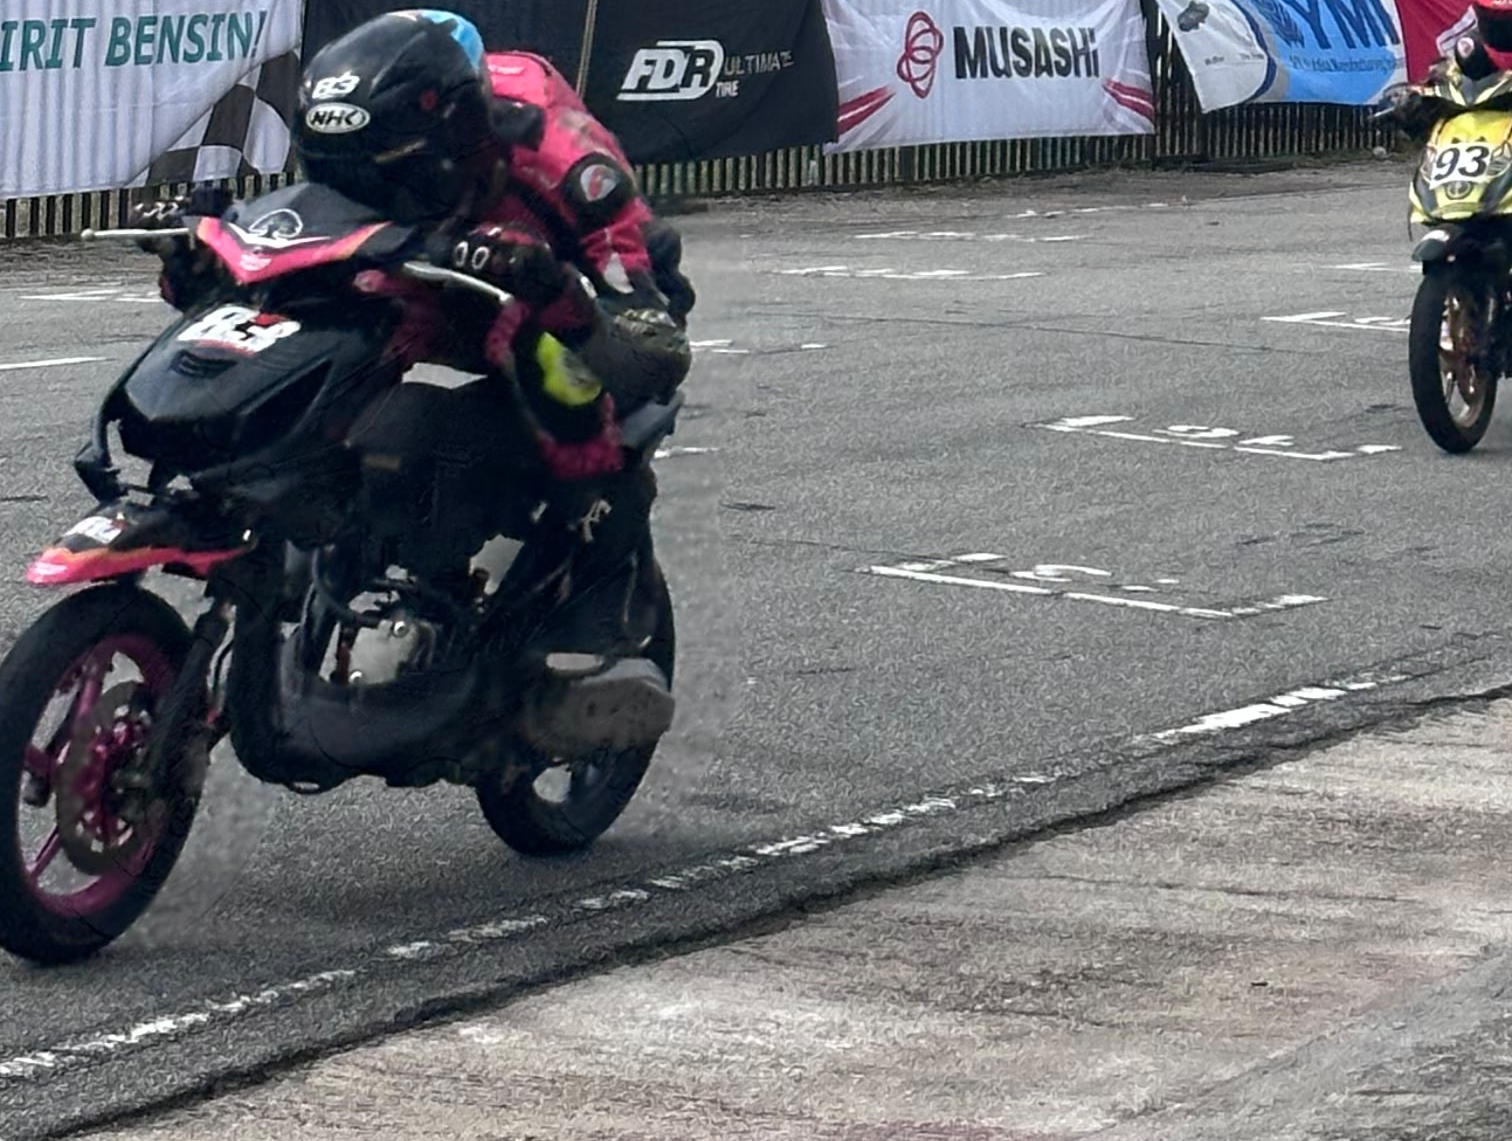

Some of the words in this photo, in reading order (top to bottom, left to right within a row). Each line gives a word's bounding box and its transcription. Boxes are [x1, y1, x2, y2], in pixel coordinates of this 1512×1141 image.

[0, 17, 97, 71] IRIT
[105, 10, 268, 67] BENSIN!
[616, 40, 725, 101] FDR
[715, 80, 741, 98] TIRE
[1434, 145, 1491, 182] 93
